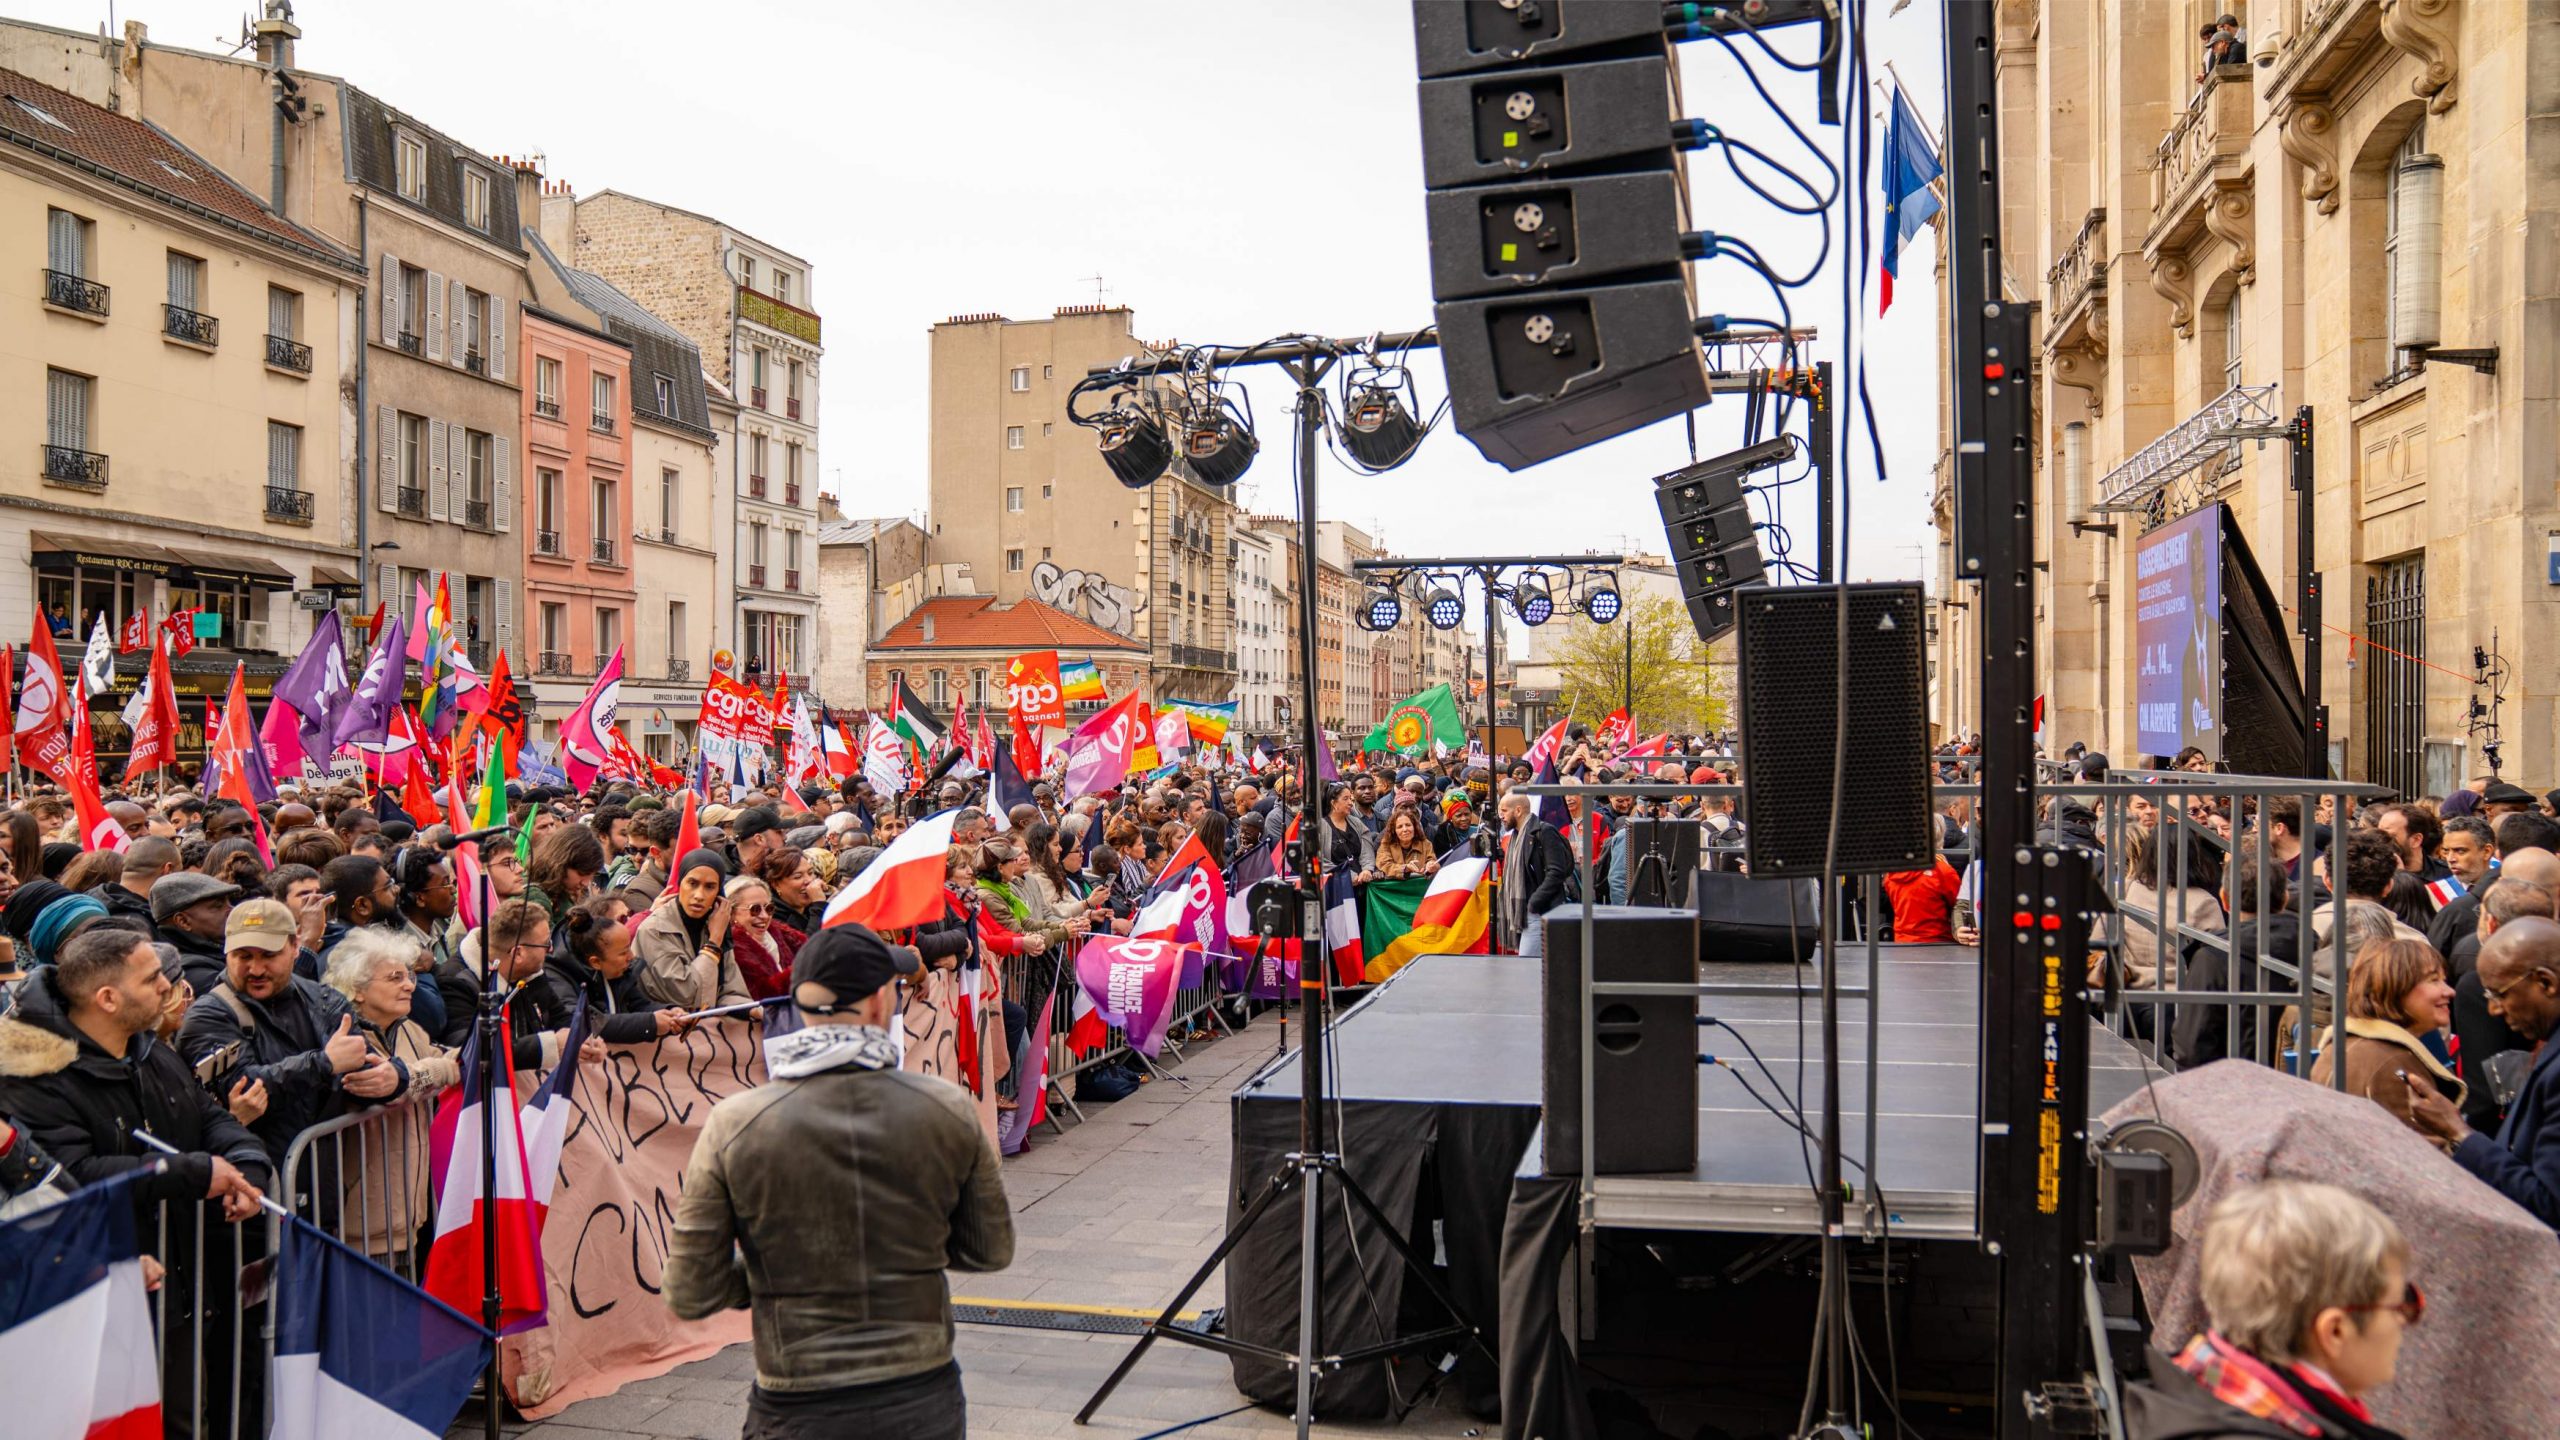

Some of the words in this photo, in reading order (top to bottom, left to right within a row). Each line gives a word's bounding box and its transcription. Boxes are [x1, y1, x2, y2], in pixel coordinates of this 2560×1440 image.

[76, 554, 115, 567] Restaurant
[115, 559, 133, 570] RDC
[653, 693, 672, 701] SERVICES
[706, 688, 745, 719] cgt
[2149, 702, 2177, 733] ARRIVE
[306, 767, 351, 780] Déage
[1143, 963, 1156, 973] LA
[1125, 963, 1143, 1014] FRANCE
[2043, 1021, 2058, 1101] FANTEK
